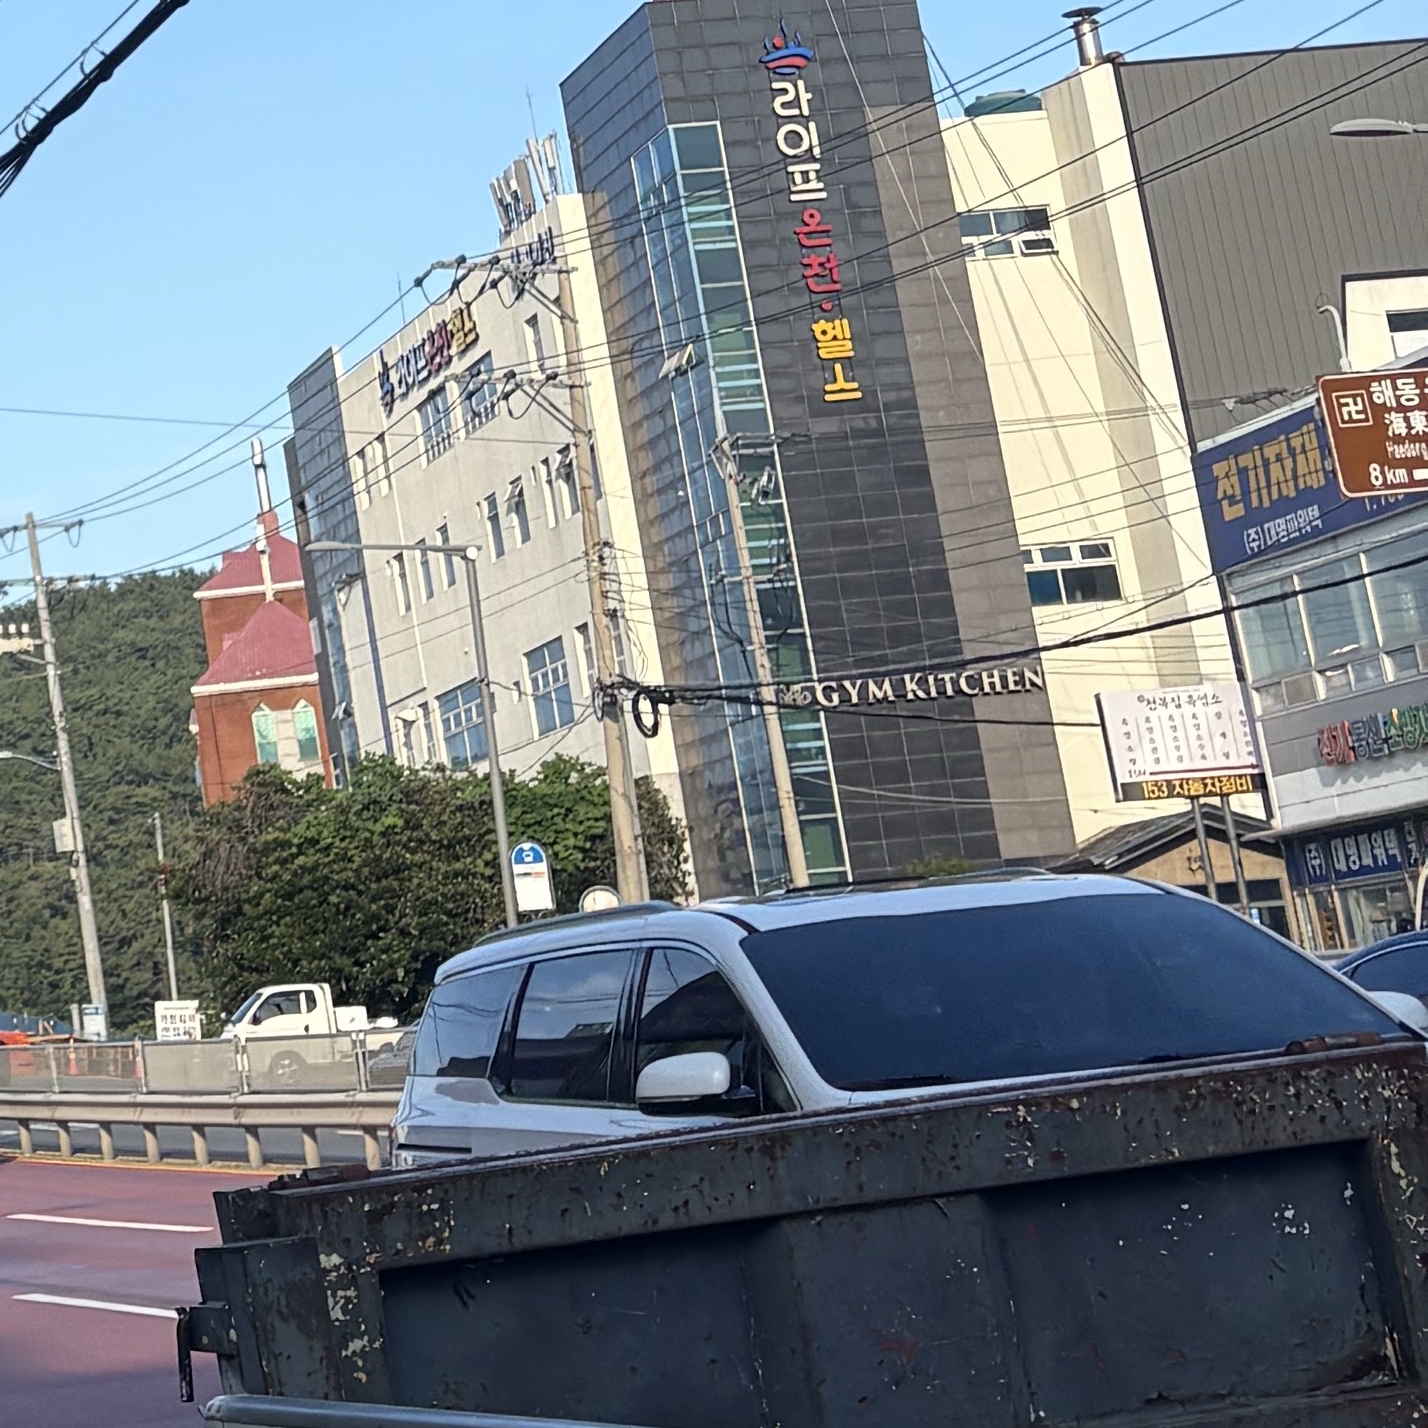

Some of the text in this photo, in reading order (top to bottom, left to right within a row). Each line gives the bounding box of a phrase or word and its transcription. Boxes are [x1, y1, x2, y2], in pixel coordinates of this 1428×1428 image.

[1369, 377, 1421, 408] 해동
[1212, 422, 1326, 522] 전기자재
[1369, 462, 1408, 487] 8 km
[815, 666, 1044, 709] GYM KITCHEN
[1141, 780, 1169, 799] 153
